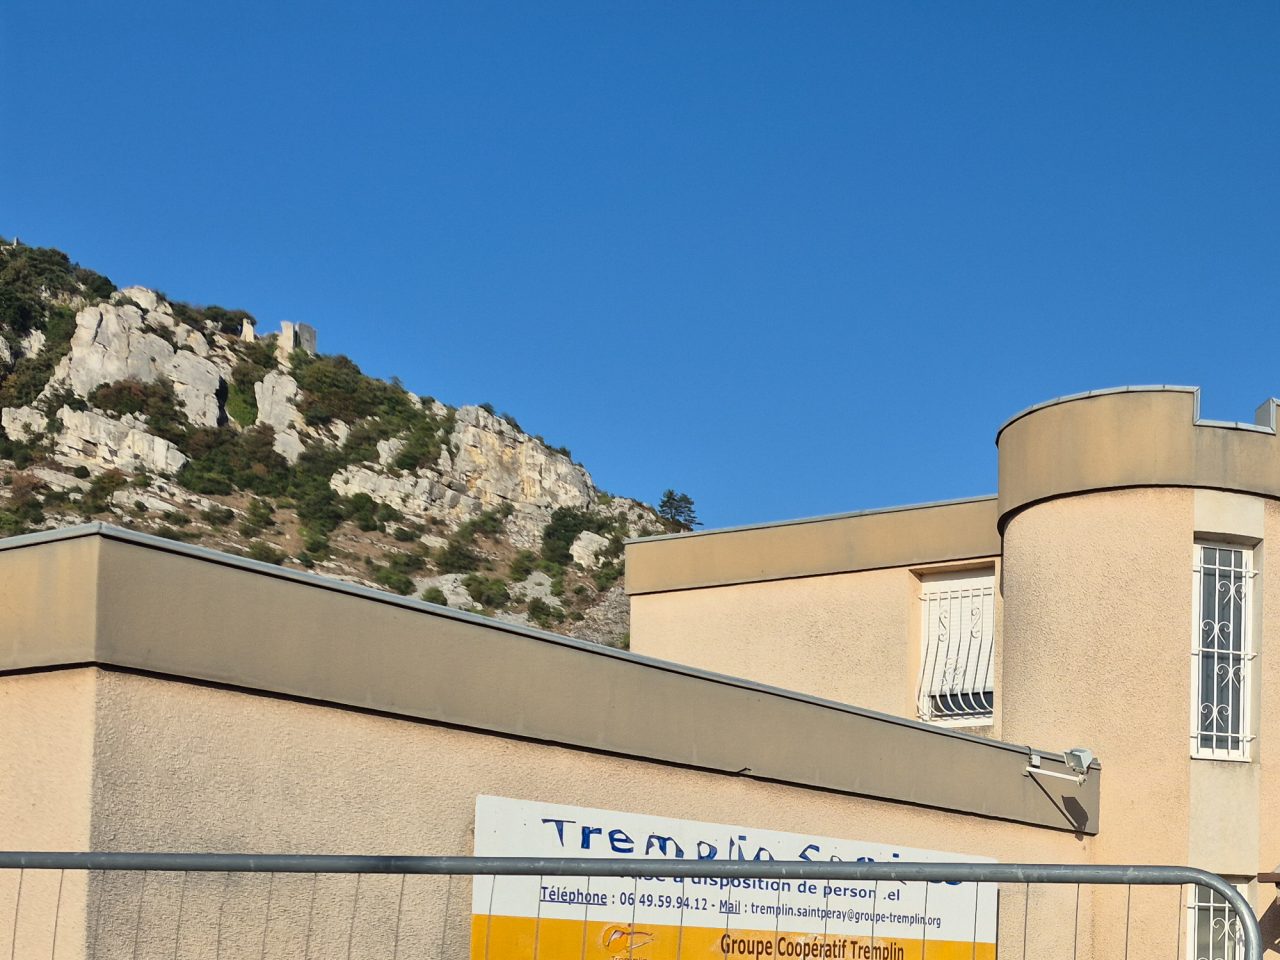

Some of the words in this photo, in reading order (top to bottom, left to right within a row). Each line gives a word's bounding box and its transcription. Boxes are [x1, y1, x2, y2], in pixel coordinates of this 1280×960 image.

[797, 880, 818, 895] de
[540, 886, 608, 906] Téléphone
[619, 892, 635, 906] 06
[638, 893, 708, 911] 49.59.94.12
[719, 899, 741, 914] Mail
[750, 902, 942, 928] tremplin.saintperay@groupe-tremplin.org
[720, 933, 773, 960] Groupe
